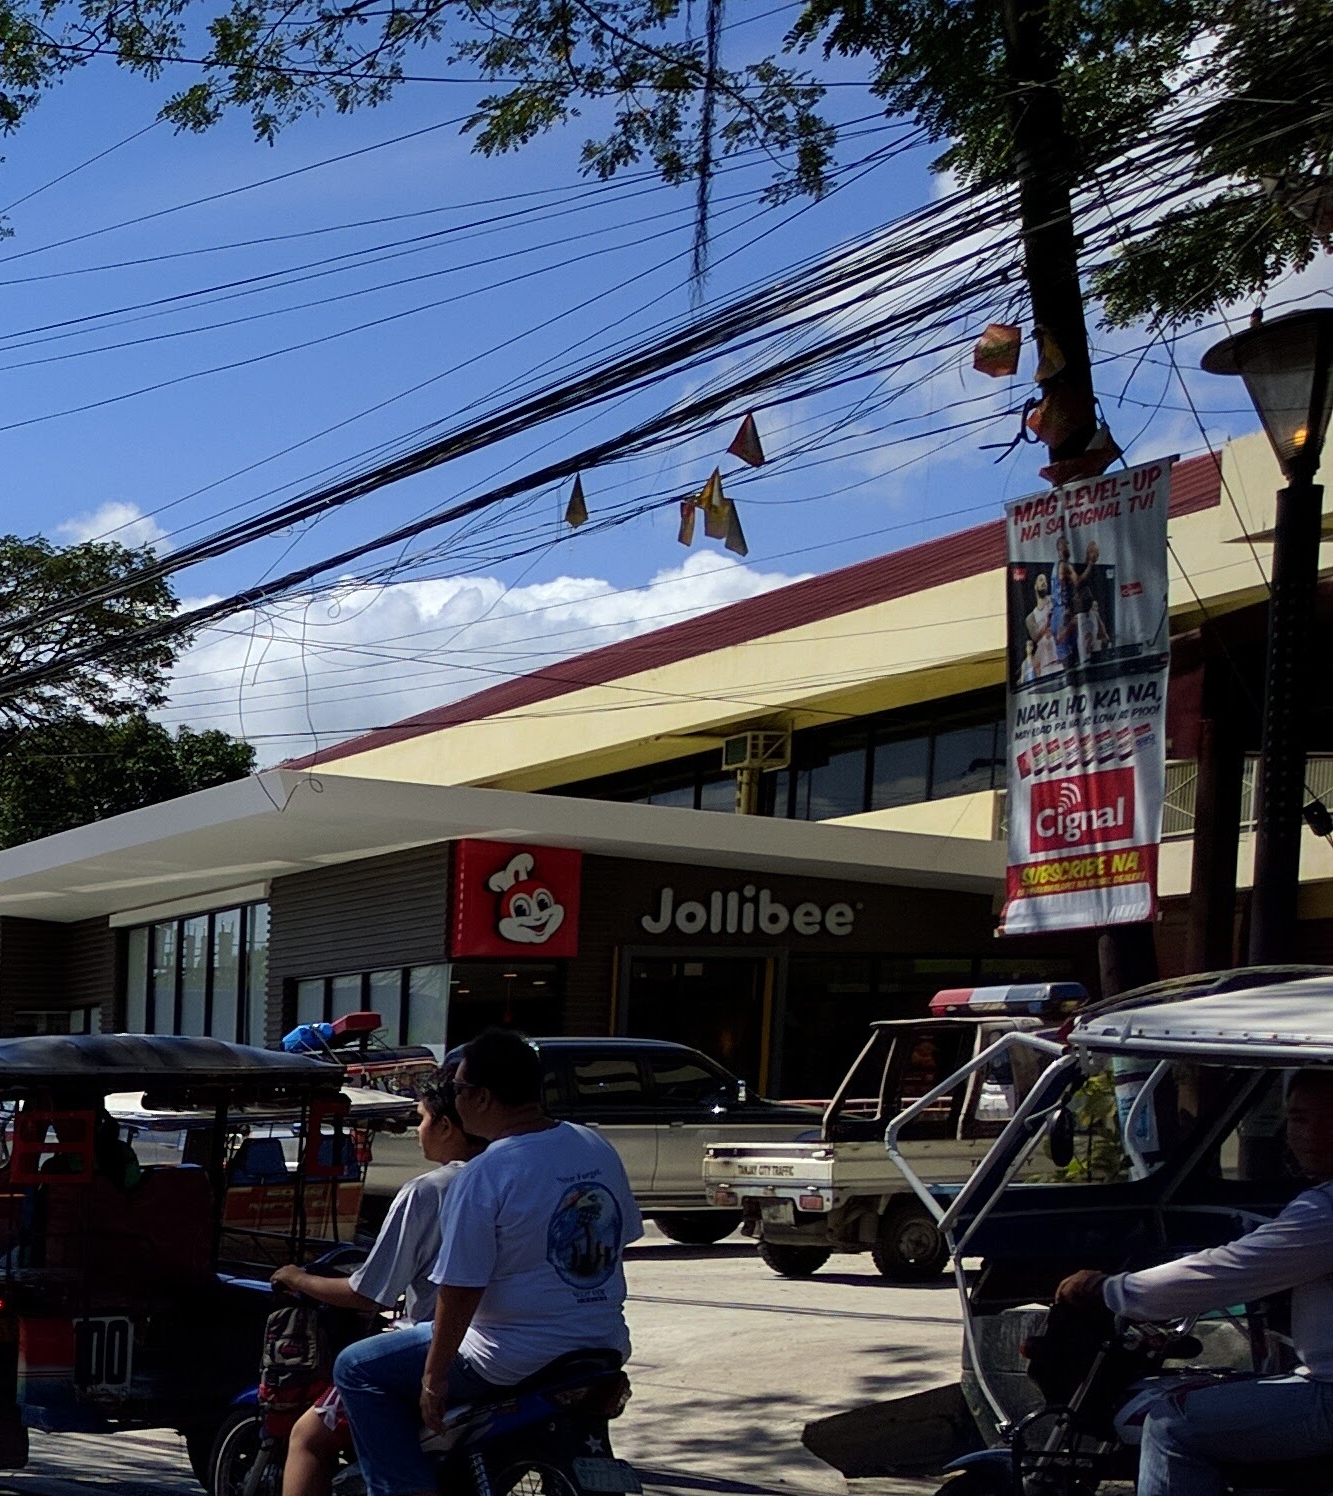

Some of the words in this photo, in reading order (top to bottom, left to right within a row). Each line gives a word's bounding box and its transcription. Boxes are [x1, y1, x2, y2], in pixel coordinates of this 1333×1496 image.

[1013, 492, 1058, 526] MAG
[1064, 465, 1163, 510] LEVEL-UP
[1020, 526, 1041, 542] NA
[1045, 514, 1066, 536] SA
[1069, 500, 1122, 529] CIGNAL
[1128, 489, 1156, 514] TV!
[1016, 698, 1060, 727] NAKA
[1093, 687, 1121, 711] KA
[1127, 680, 1163, 703] NA,
[1094, 713, 1116, 725] LOW
[1035, 796, 1125, 842] Cignal
[1020, 855, 1107, 886] SUBSCRIBE
[1111, 851, 1140, 873] NA
[641, 884, 855, 936] Jollibee
